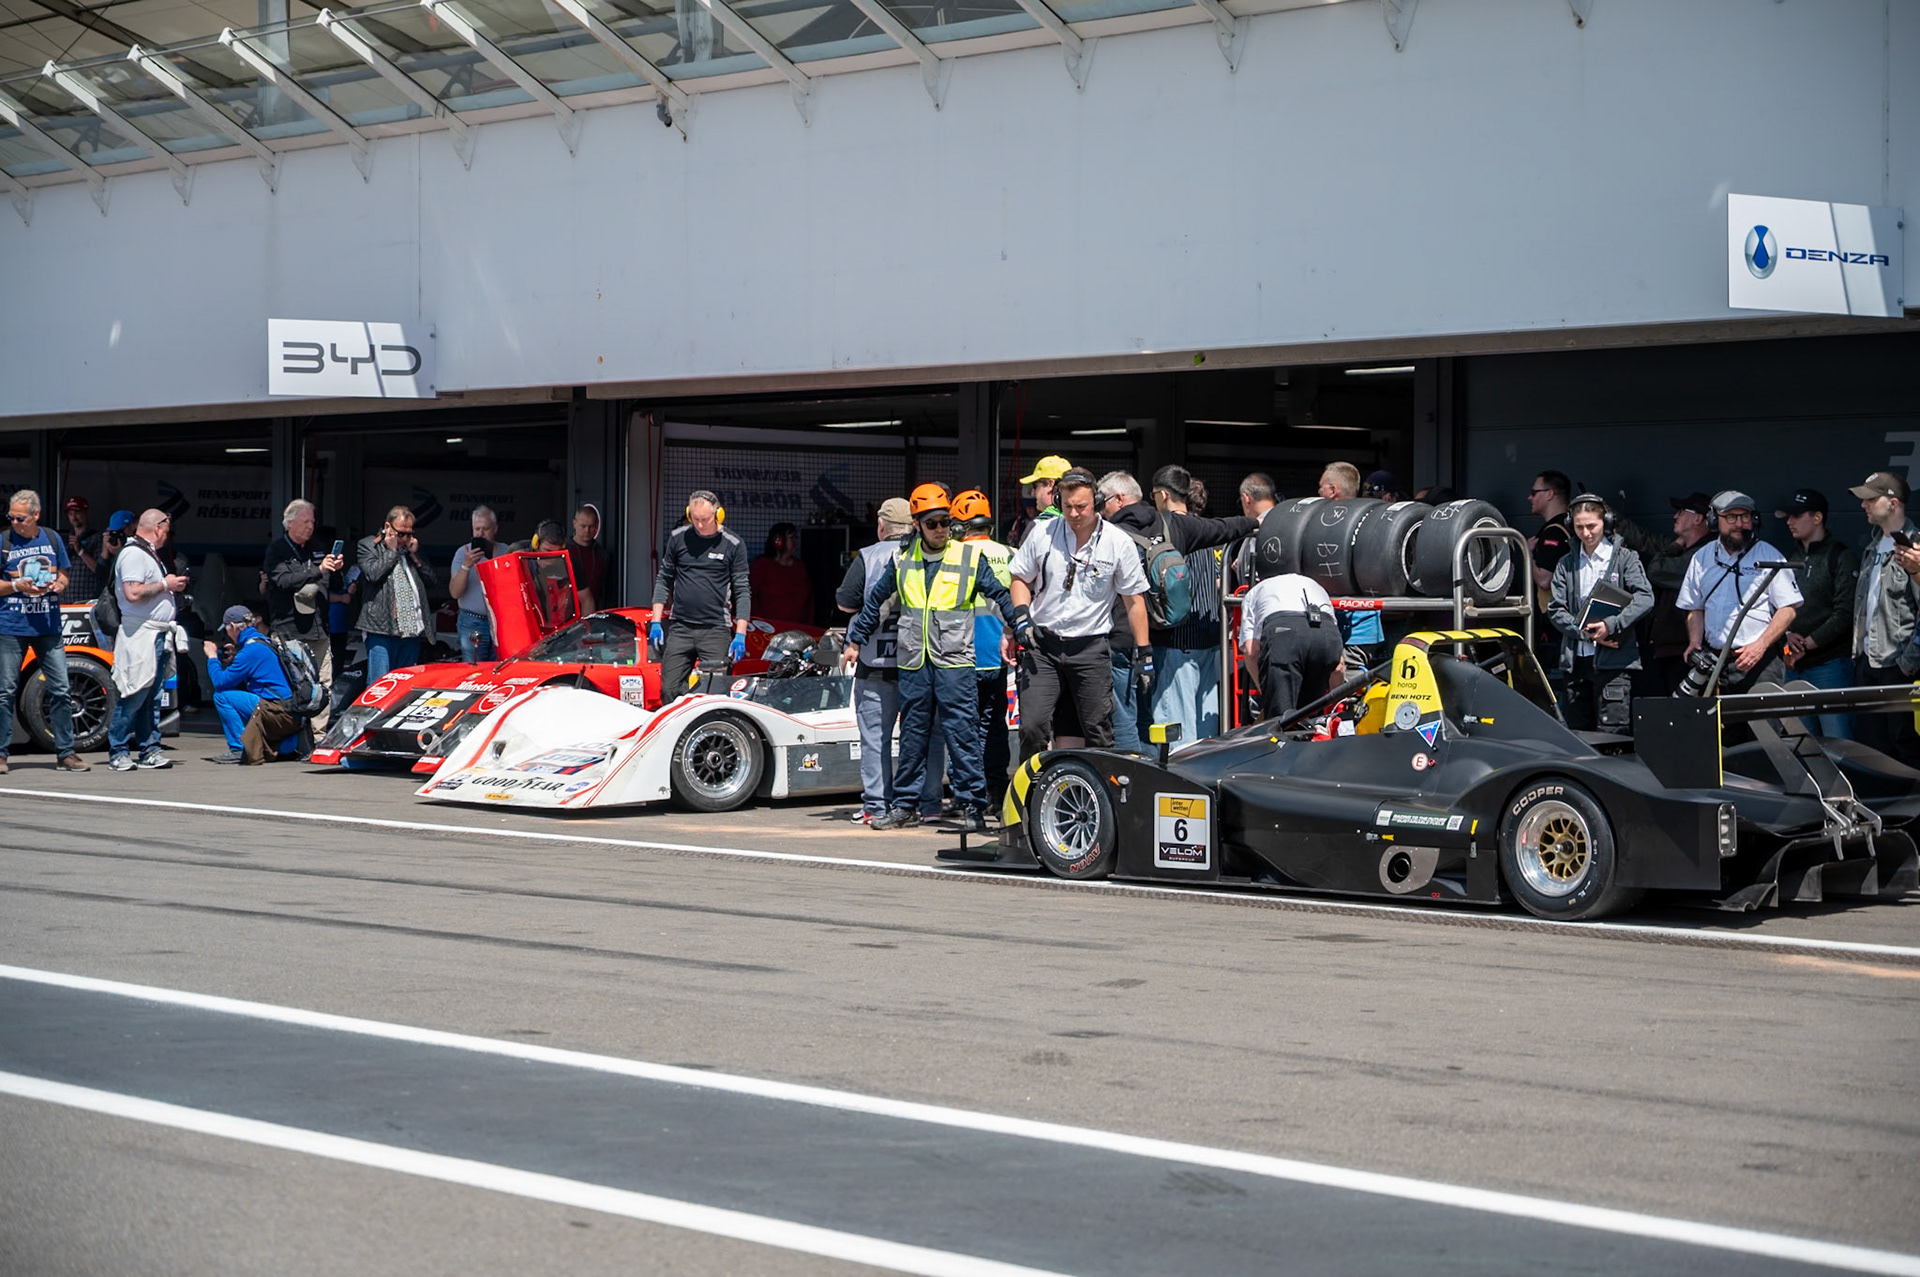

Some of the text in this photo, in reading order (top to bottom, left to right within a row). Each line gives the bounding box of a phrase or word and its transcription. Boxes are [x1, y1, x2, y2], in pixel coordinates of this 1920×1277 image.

[1785, 247, 1889, 266] DENZA
[283, 341, 422, 376] BYD
[197, 489, 271, 500] RENNSPORT
[197, 504, 272, 519] RÖSSLER
[450, 507, 516, 522] RÖER
[987, 556, 1006, 565] SHAL
[1339, 599, 1375, 608] RACING
[621, 678, 642, 686] CAMEL
[416, 706, 437, 716] 25
[1416, 756, 1424, 767] E
[1512, 786, 1564, 816] COOPER
[1174, 819, 1188, 842] 6
[1161, 846, 1203, 856] VELOM
[1069, 842, 1101, 874] AVON
